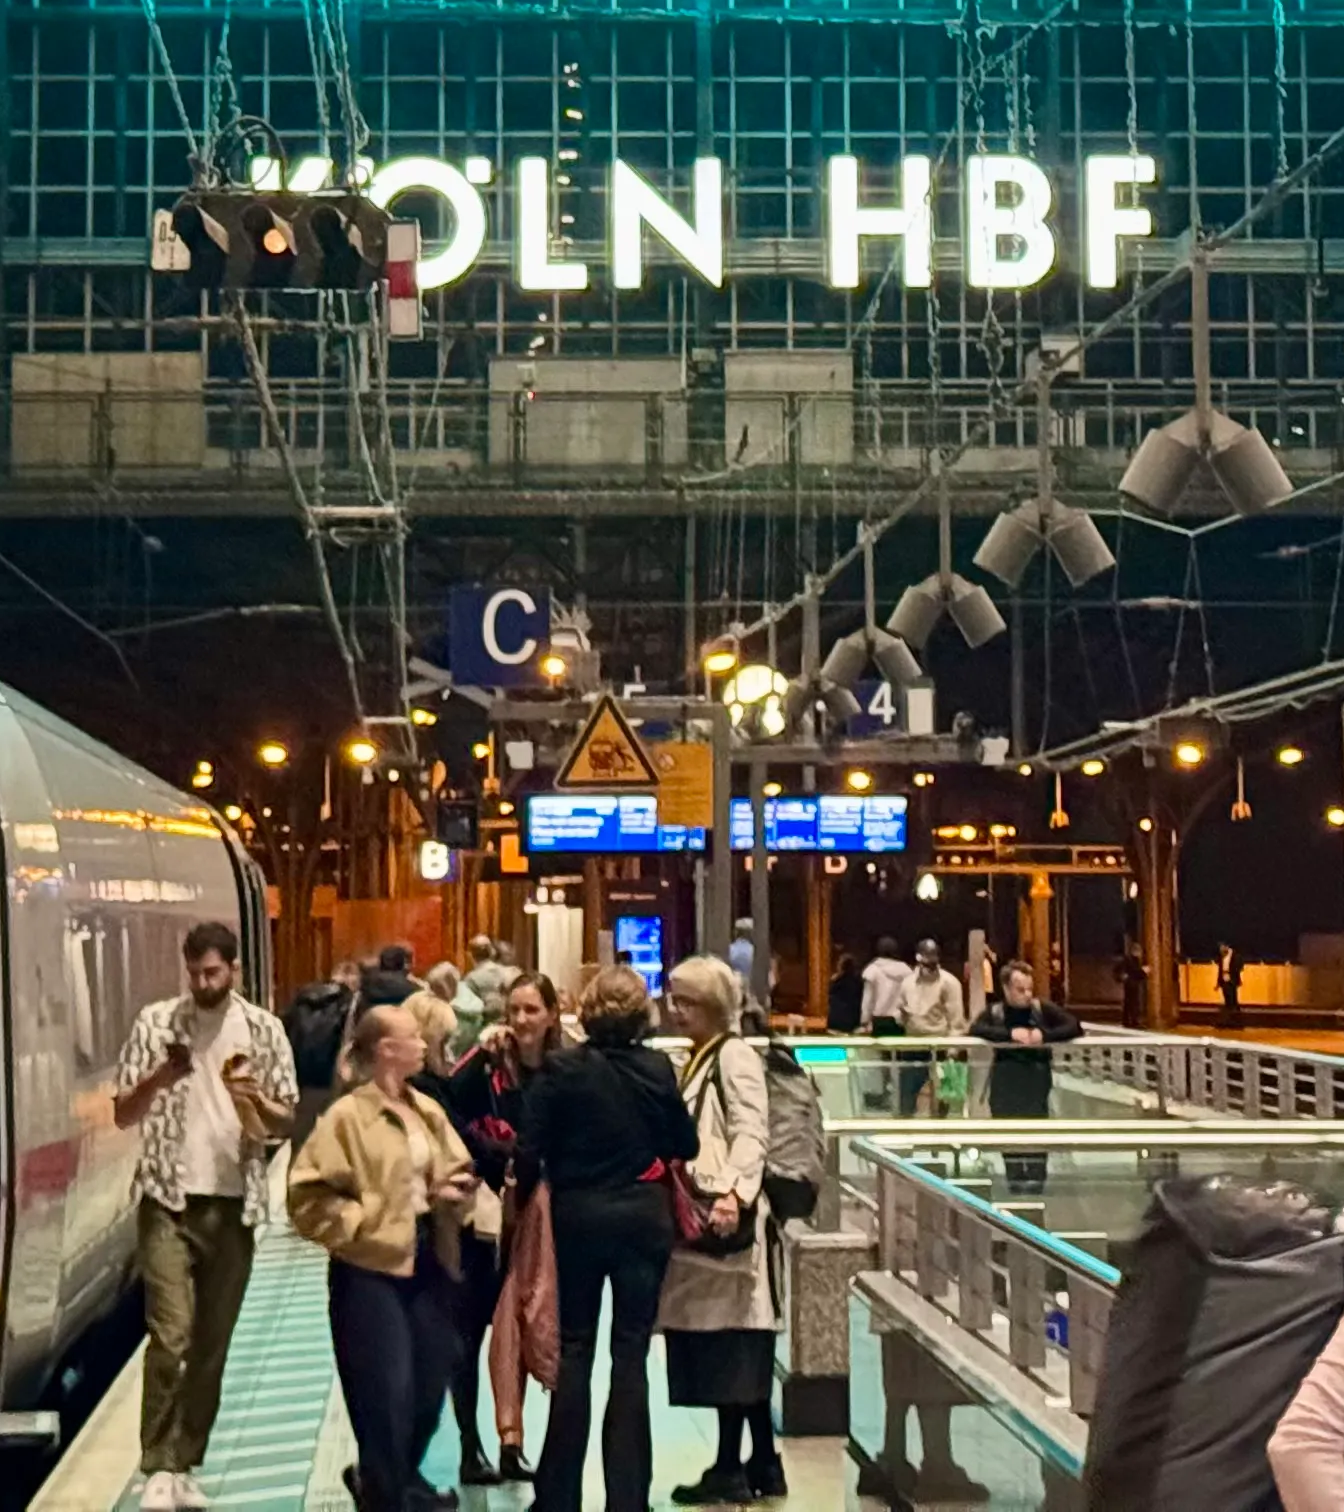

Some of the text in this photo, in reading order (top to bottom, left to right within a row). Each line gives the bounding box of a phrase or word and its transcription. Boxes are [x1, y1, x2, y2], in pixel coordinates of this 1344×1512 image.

[250, 153, 1158, 291] ÖLN HBF
[482, 588, 537, 665] C
[867, 680, 897, 725] 4
